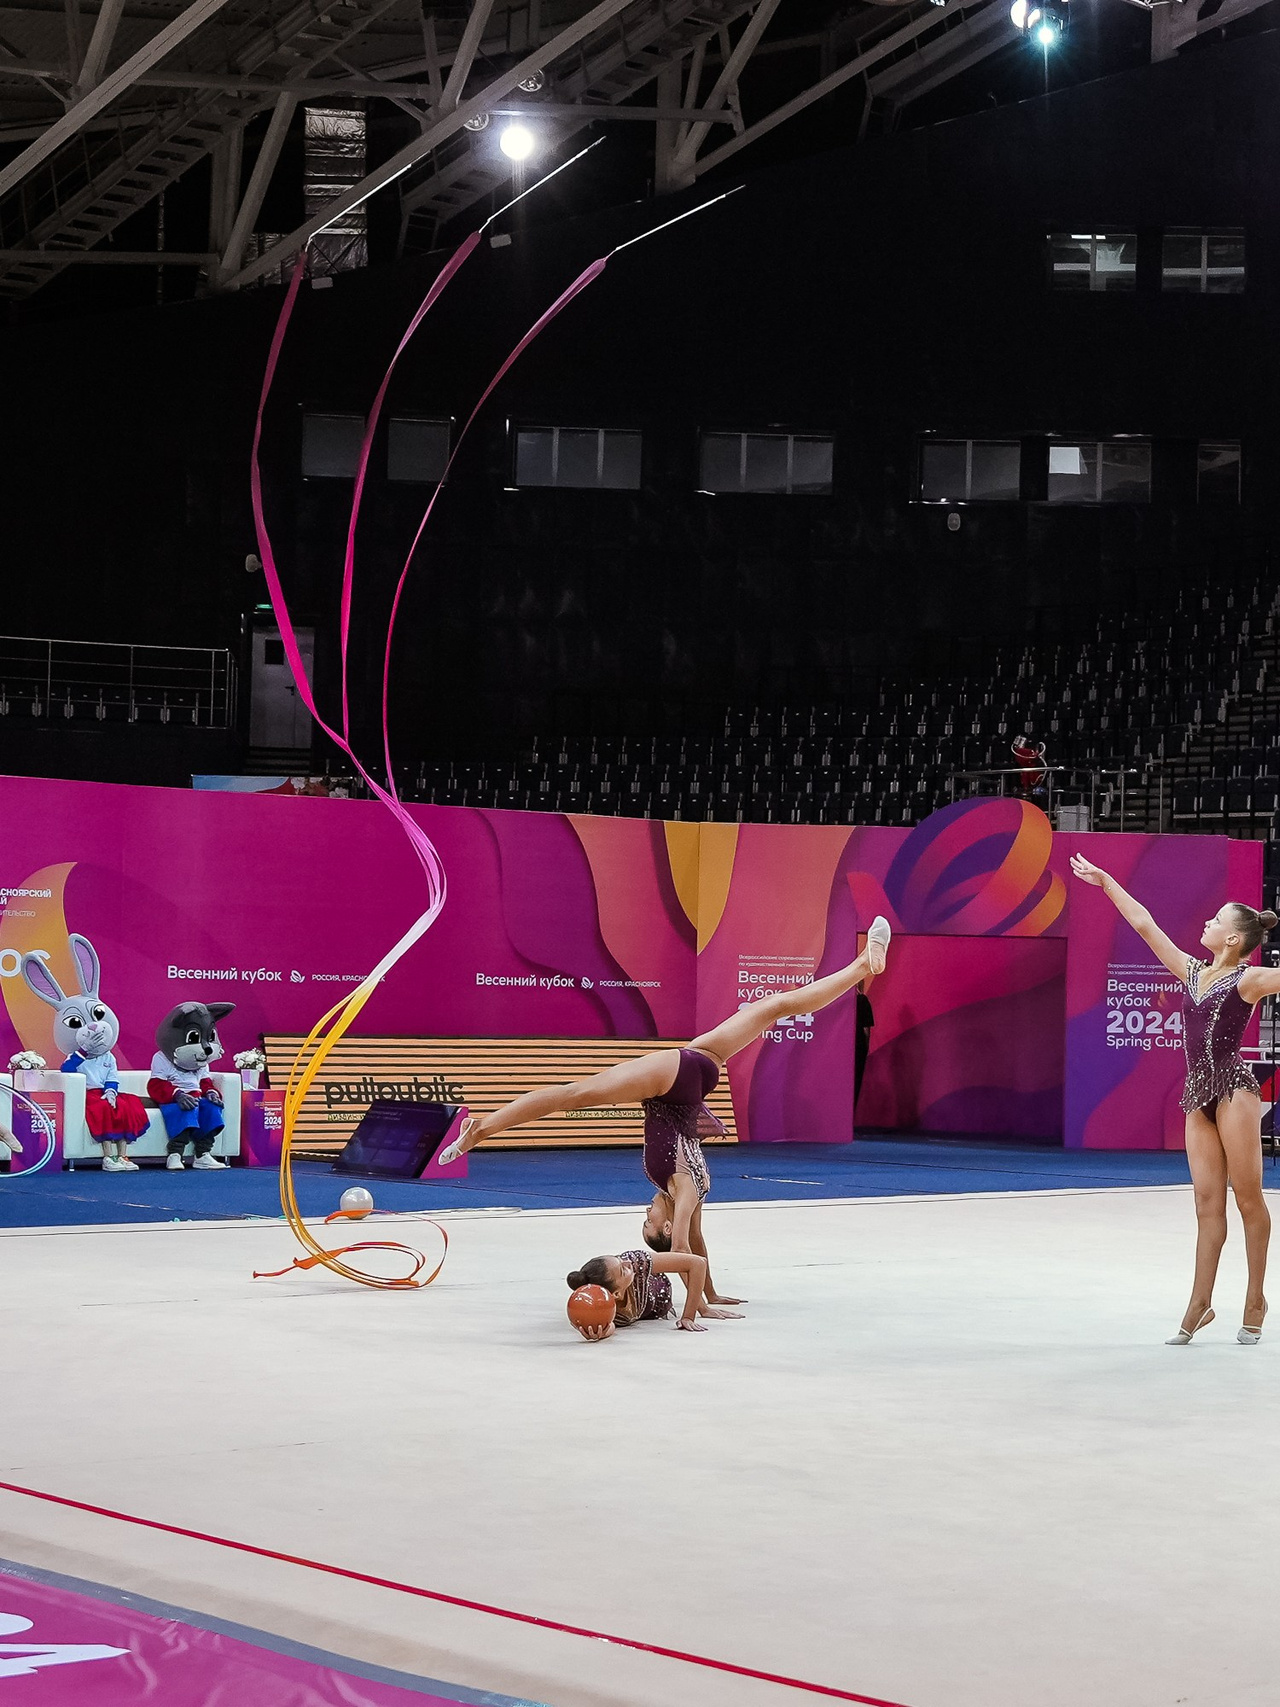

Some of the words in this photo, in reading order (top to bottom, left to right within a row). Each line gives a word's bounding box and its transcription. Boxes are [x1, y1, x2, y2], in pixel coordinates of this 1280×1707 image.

[167, 965, 238, 980] Весенний
[241, 968, 282, 984] кубок
[312, 974, 341, 983] РОССИЯ,
[476, 972, 537, 987] Весенний
[540, 975, 575, 990] кубок
[738, 970, 814, 984] Весенний
[1107, 979, 1183, 993] Весенний
[1107, 994, 1151, 1009] кубок
[1106, 1010, 1183, 1034] 2024
[786, 1028, 814, 1042] Cup
[1106, 1035, 1152, 1051] Spring
[1155, 1036, 1182, 1050] Cup
[325, 1075, 465, 1108] pullpublic
